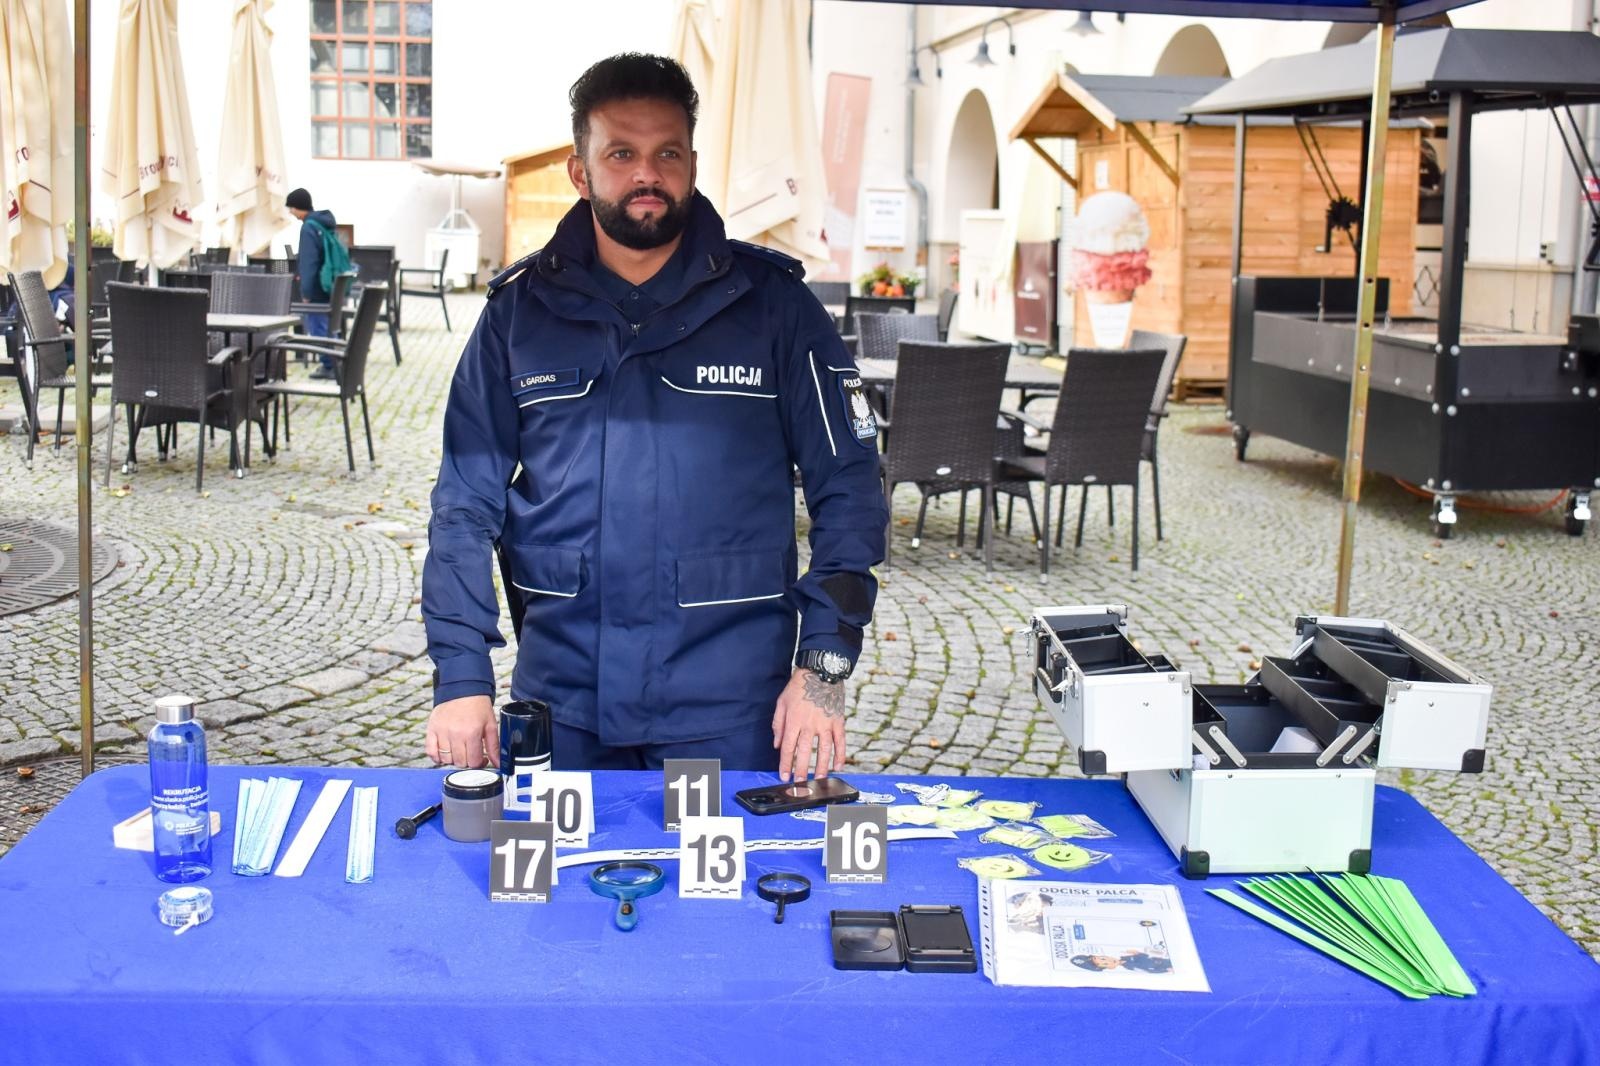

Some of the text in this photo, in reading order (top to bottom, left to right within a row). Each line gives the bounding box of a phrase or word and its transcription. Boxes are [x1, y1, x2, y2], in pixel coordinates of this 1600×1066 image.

[526, 374, 557, 386] GARDAS
[696, 365, 762, 386] POLICJA
[163, 785, 202, 796] REKRUTACJA
[536, 787, 582, 834] 10
[668, 774, 709, 819] 11
[494, 838, 547, 889] 17
[687, 834, 737, 884] 13
[831, 821, 881, 871] 16
[1039, 887, 1138, 896] ODCISK PALCA
